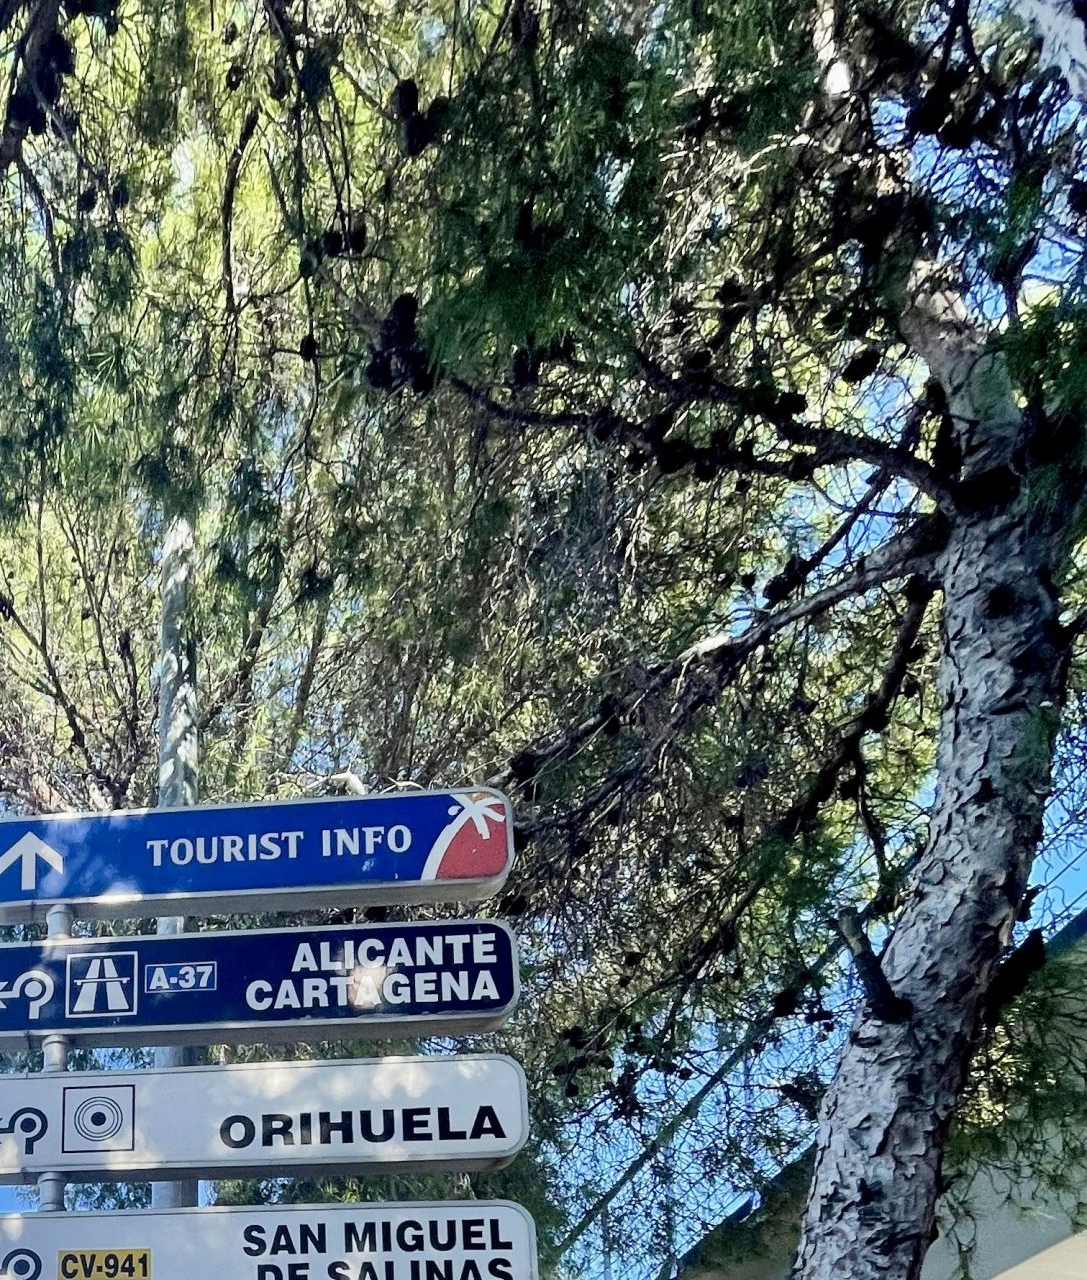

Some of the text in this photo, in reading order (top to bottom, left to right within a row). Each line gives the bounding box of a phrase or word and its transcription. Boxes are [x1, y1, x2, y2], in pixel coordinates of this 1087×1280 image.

[146, 825, 412, 867] TOURIST INFO
[292, 933, 498, 973] ALICANTE
[149, 966, 213, 990] A-37
[245, 971, 500, 1010] CARTAGENA
[219, 1105, 507, 1149] ORIHUELA
[243, 1218, 513, 1256] SAN MIGUEL
[60, 1254, 149, 1280] CV-941
